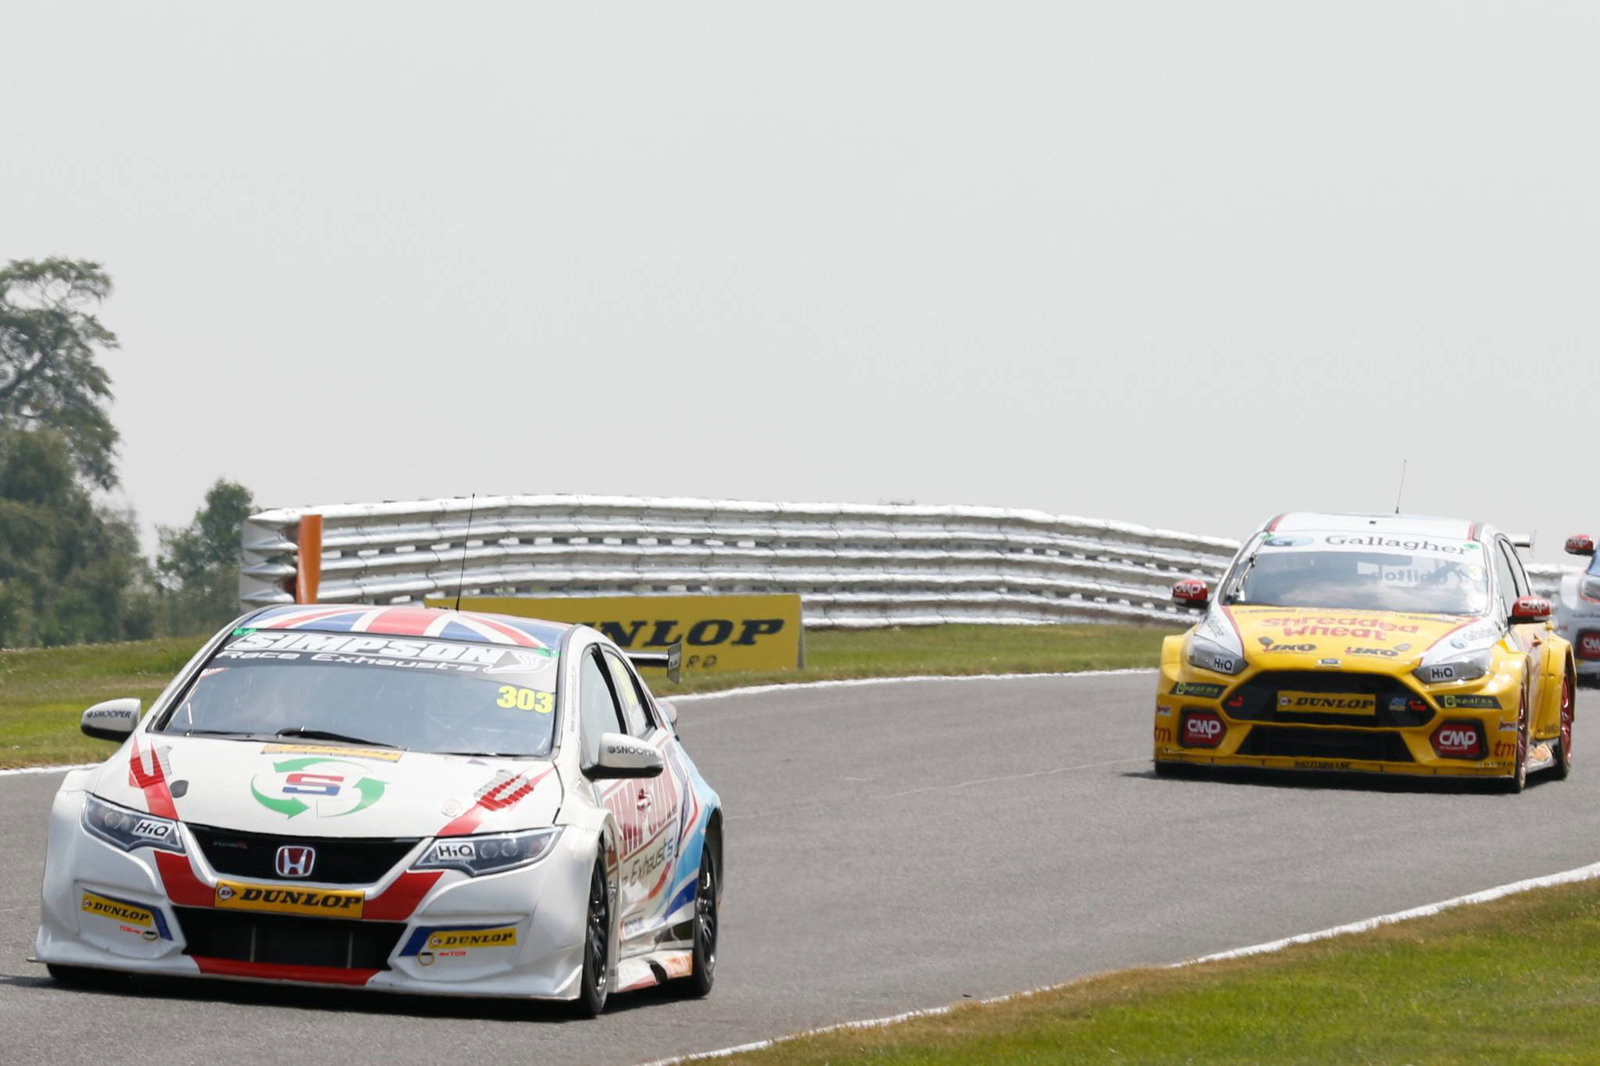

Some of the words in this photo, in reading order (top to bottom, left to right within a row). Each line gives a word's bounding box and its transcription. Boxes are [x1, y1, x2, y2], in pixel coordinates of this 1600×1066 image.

[582, 619, 785, 647] NLOP
[224, 632, 512, 665] SIMPSON
[215, 650, 301, 660] Race
[310, 653, 480, 673] Exhausts
[1431, 667, 1454, 679] HiQ
[496, 685, 553, 714] 303
[1295, 697, 1374, 709] DUNLOP
[1187, 719, 1221, 739] CMP
[1438, 730, 1477, 750] CMP
[135, 822, 169, 837] HiQ
[439, 844, 473, 858] HiQ
[240, 887, 362, 909] DUNLOP
[93, 901, 150, 921] DUNLOP
[444, 932, 513, 946] DUNLOP
